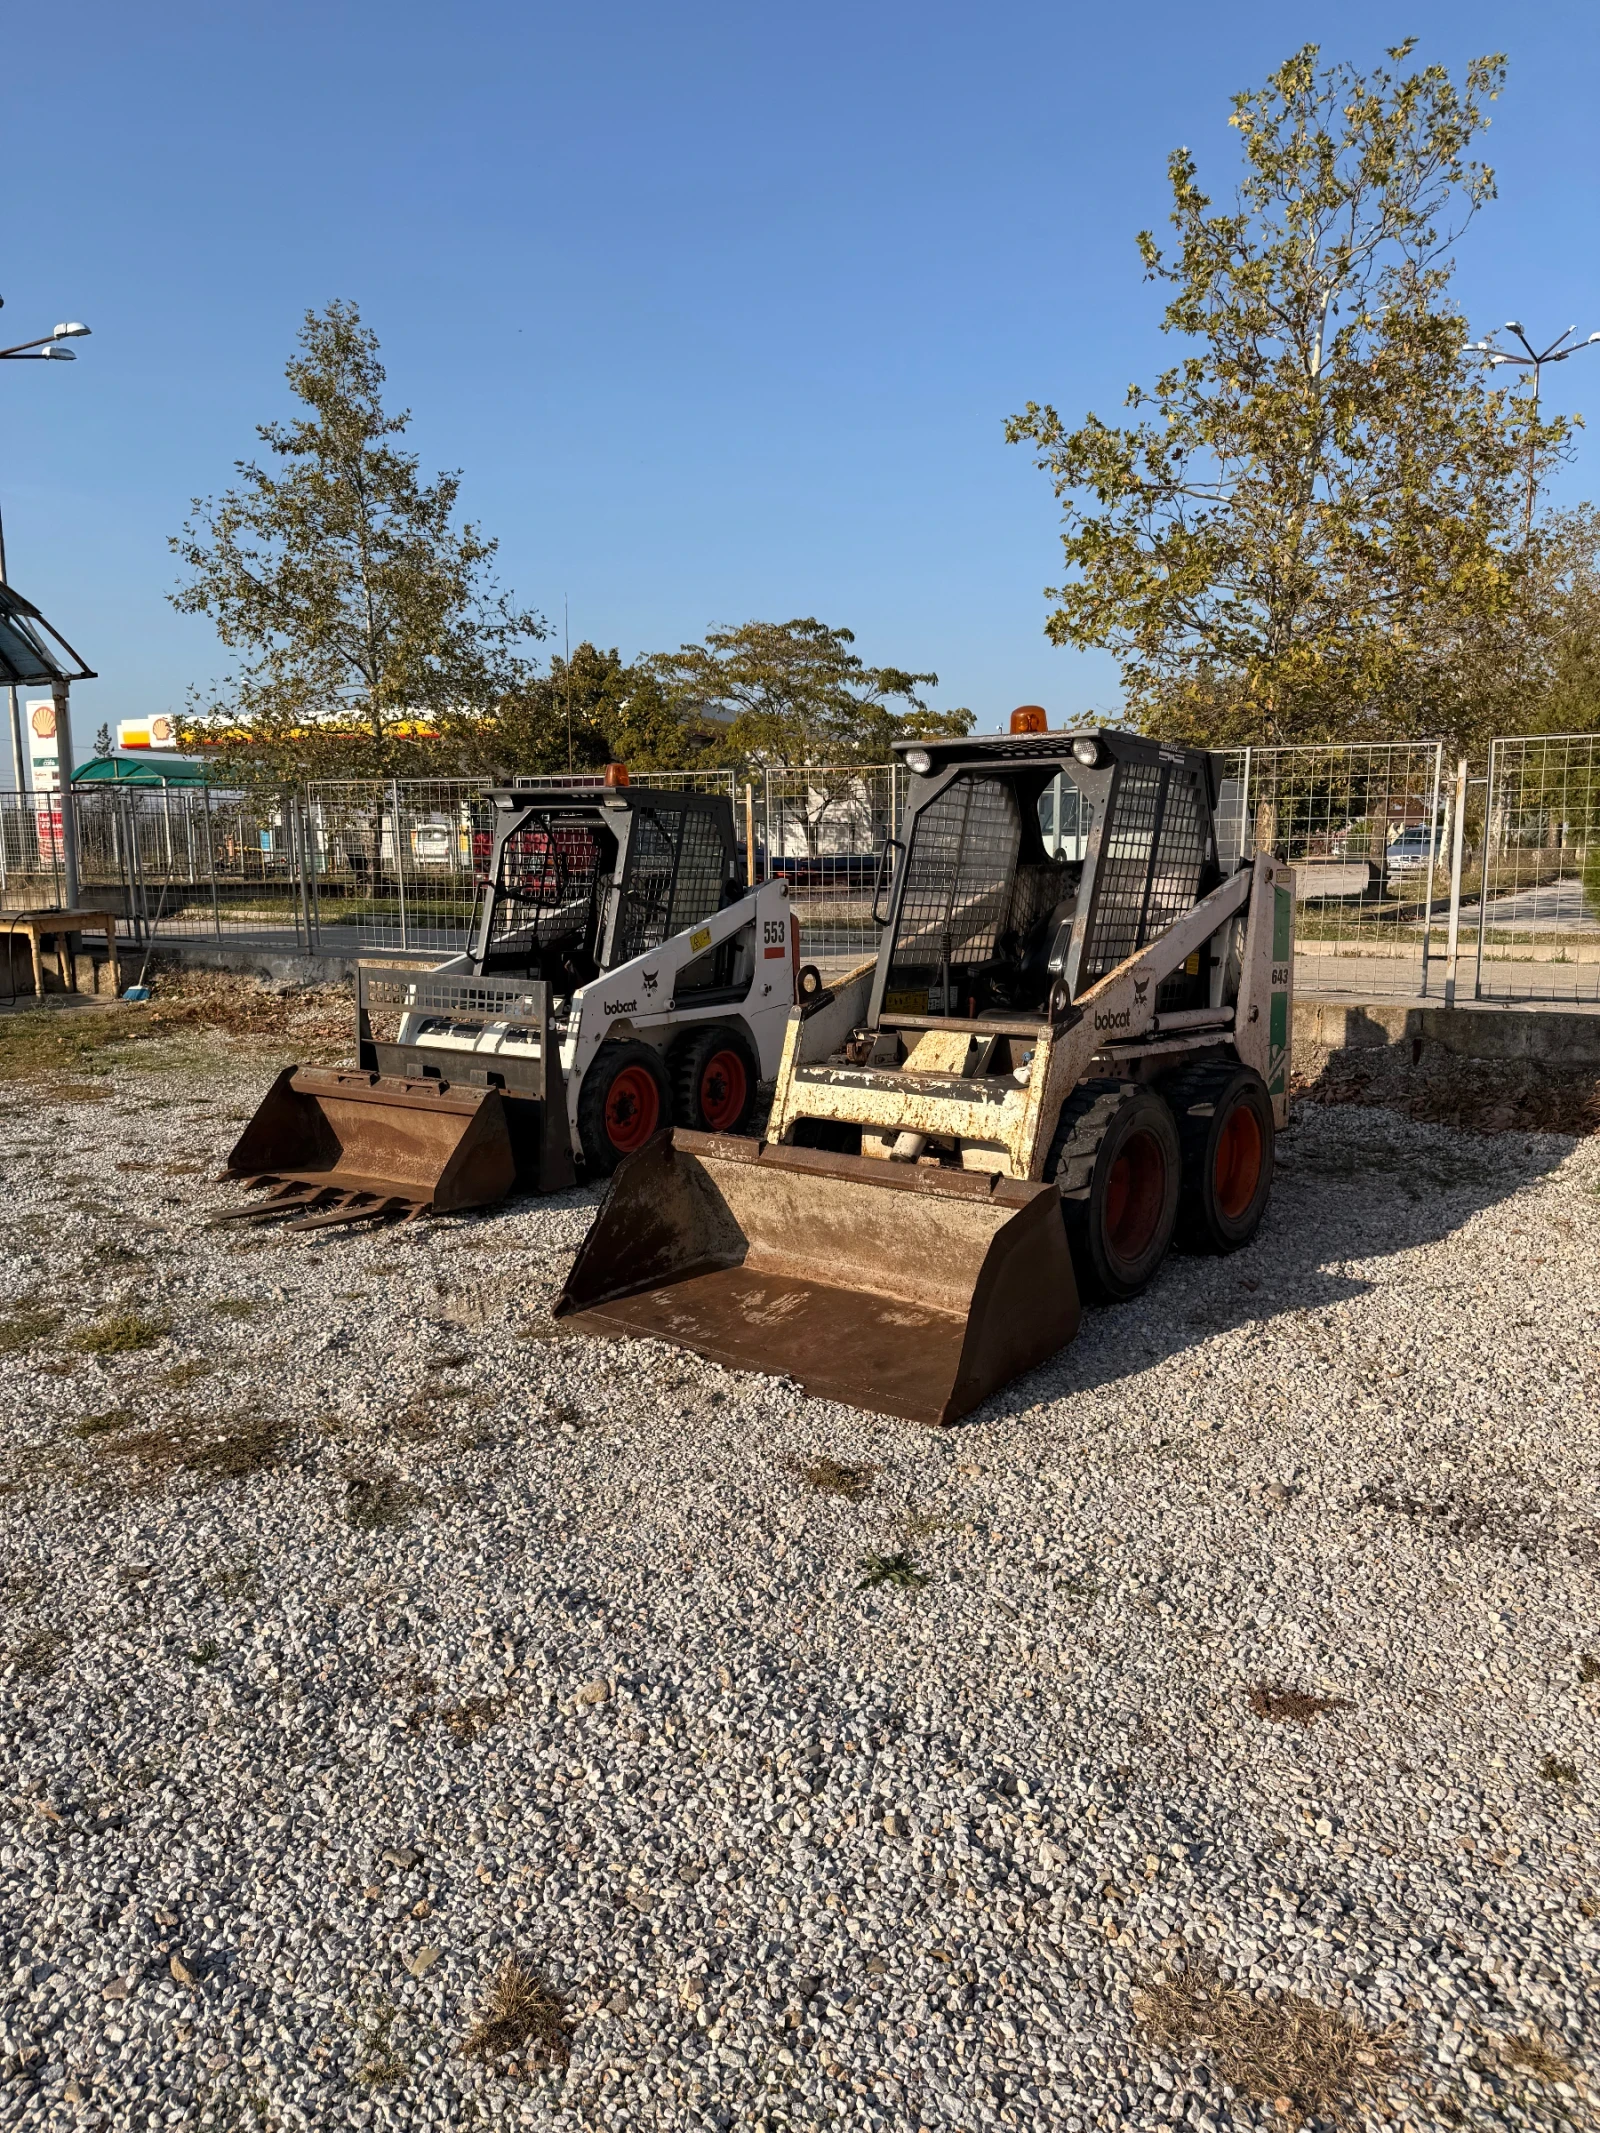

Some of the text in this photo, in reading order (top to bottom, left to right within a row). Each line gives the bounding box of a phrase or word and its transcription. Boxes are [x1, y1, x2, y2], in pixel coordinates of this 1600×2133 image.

[764, 920, 785, 944] 553
[1271, 969, 1289, 985] 643
[604, 999, 638, 1016] bobcat
[1094, 1007, 1131, 1031] bobcat
